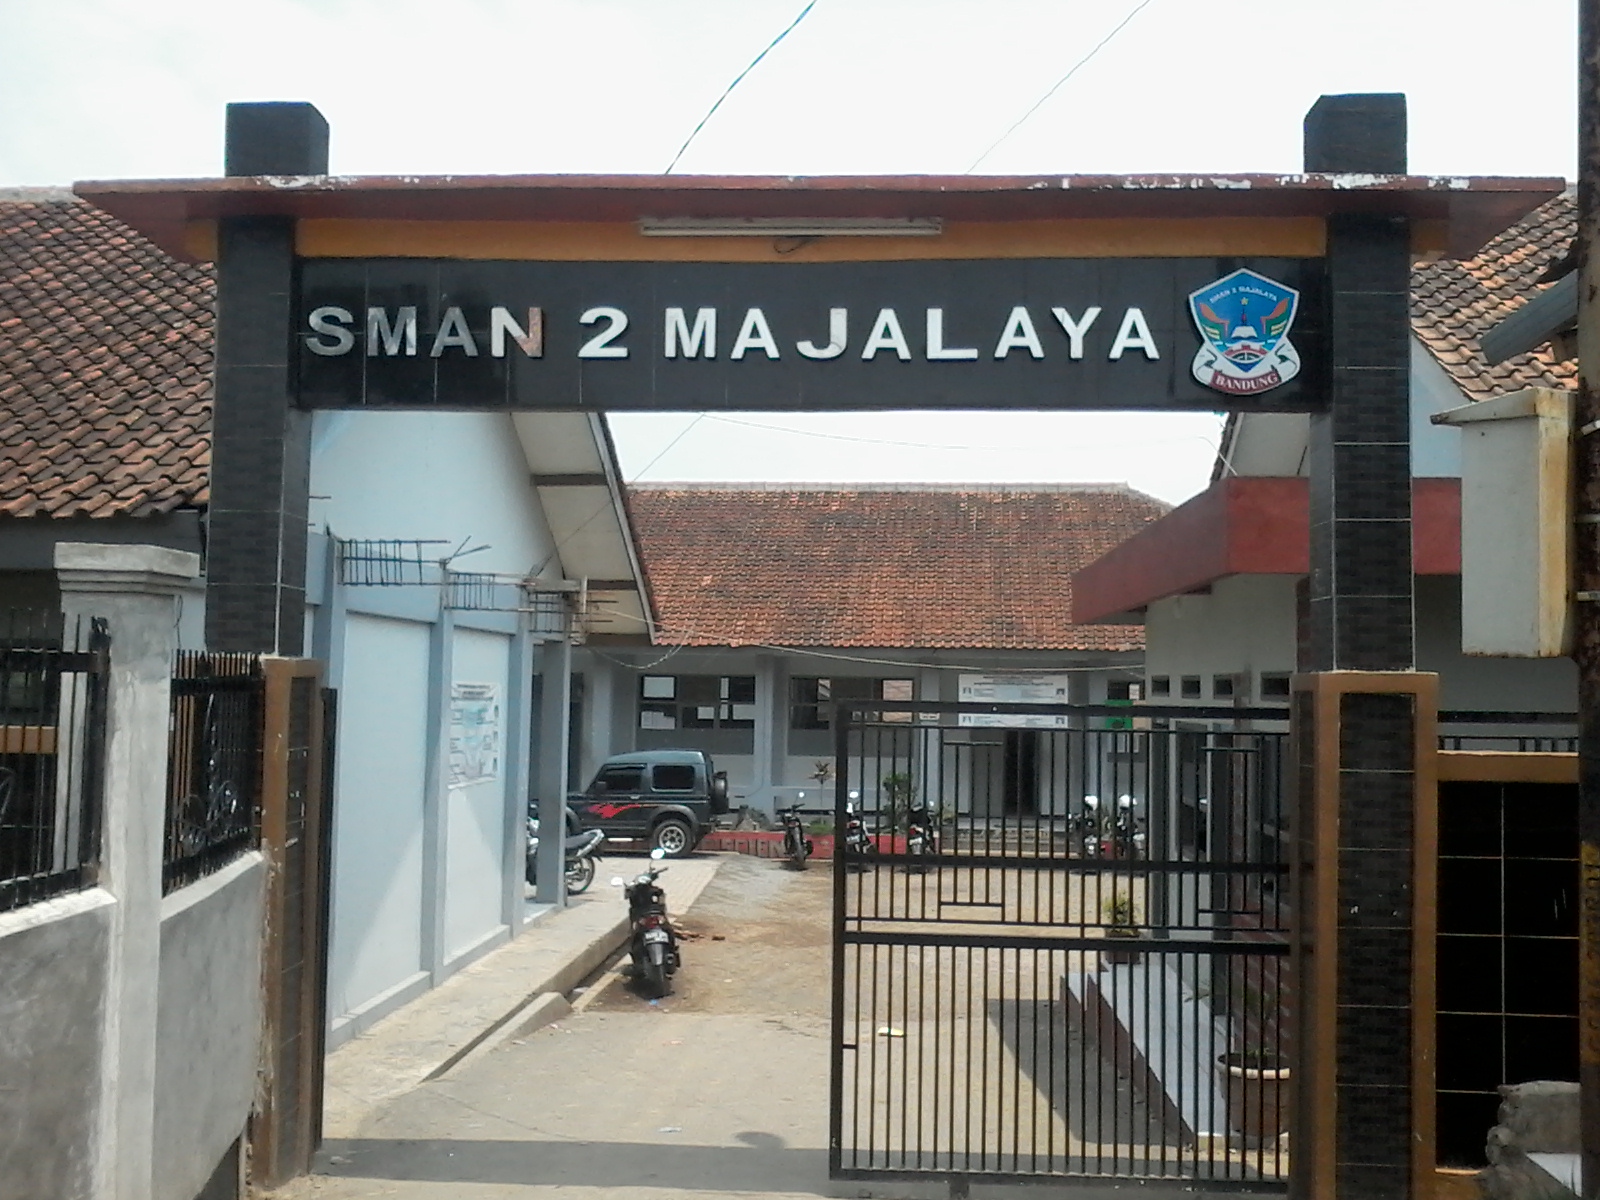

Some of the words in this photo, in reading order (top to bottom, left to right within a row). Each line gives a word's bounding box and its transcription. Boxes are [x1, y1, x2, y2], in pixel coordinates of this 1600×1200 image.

[306, 305, 544, 358] SMAN
[577, 306, 629, 359] 2
[663, 306, 1161, 360] MAJALAYA
[1215, 373, 1278, 390] BANDUNG
